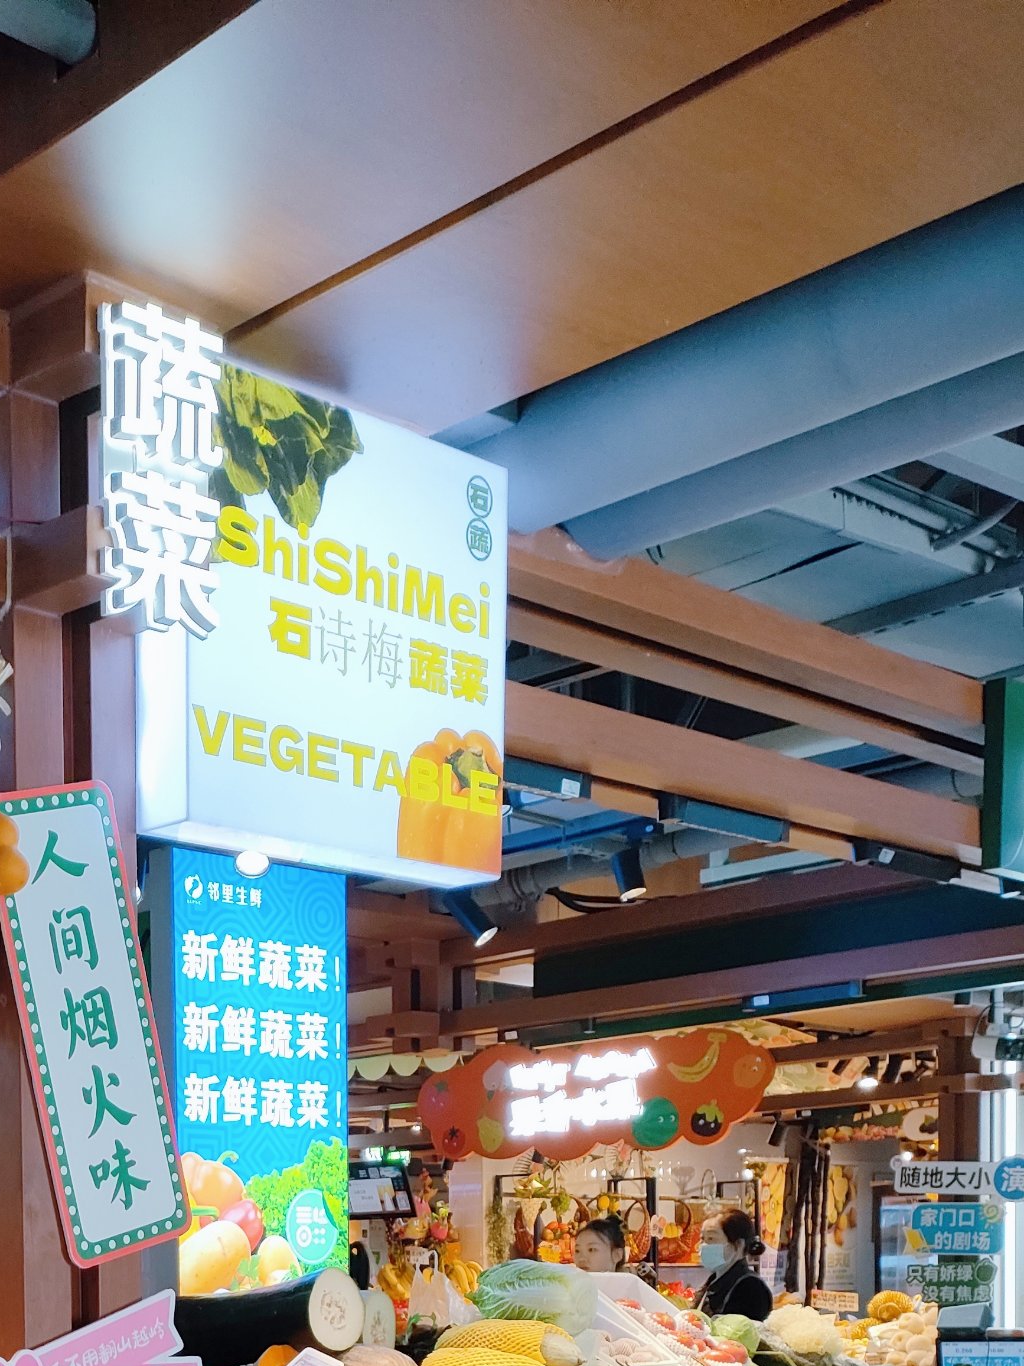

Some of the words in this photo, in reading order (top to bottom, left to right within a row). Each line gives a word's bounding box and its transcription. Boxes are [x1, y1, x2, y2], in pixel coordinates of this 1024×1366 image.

[103, 302, 224, 640] 蔬菜
[217, 505, 491, 638] ShiShiMei
[268, 596, 489, 705] 石诗梅蔬菜
[192, 703, 499, 816] VEGETABLE
[207, 881, 262, 908] 邻里生鲜
[31, 829, 150, 1211] 人间烟火味
[920, 1207, 975, 1228] 家门口
[934, 1231, 991, 1251] 的剧场
